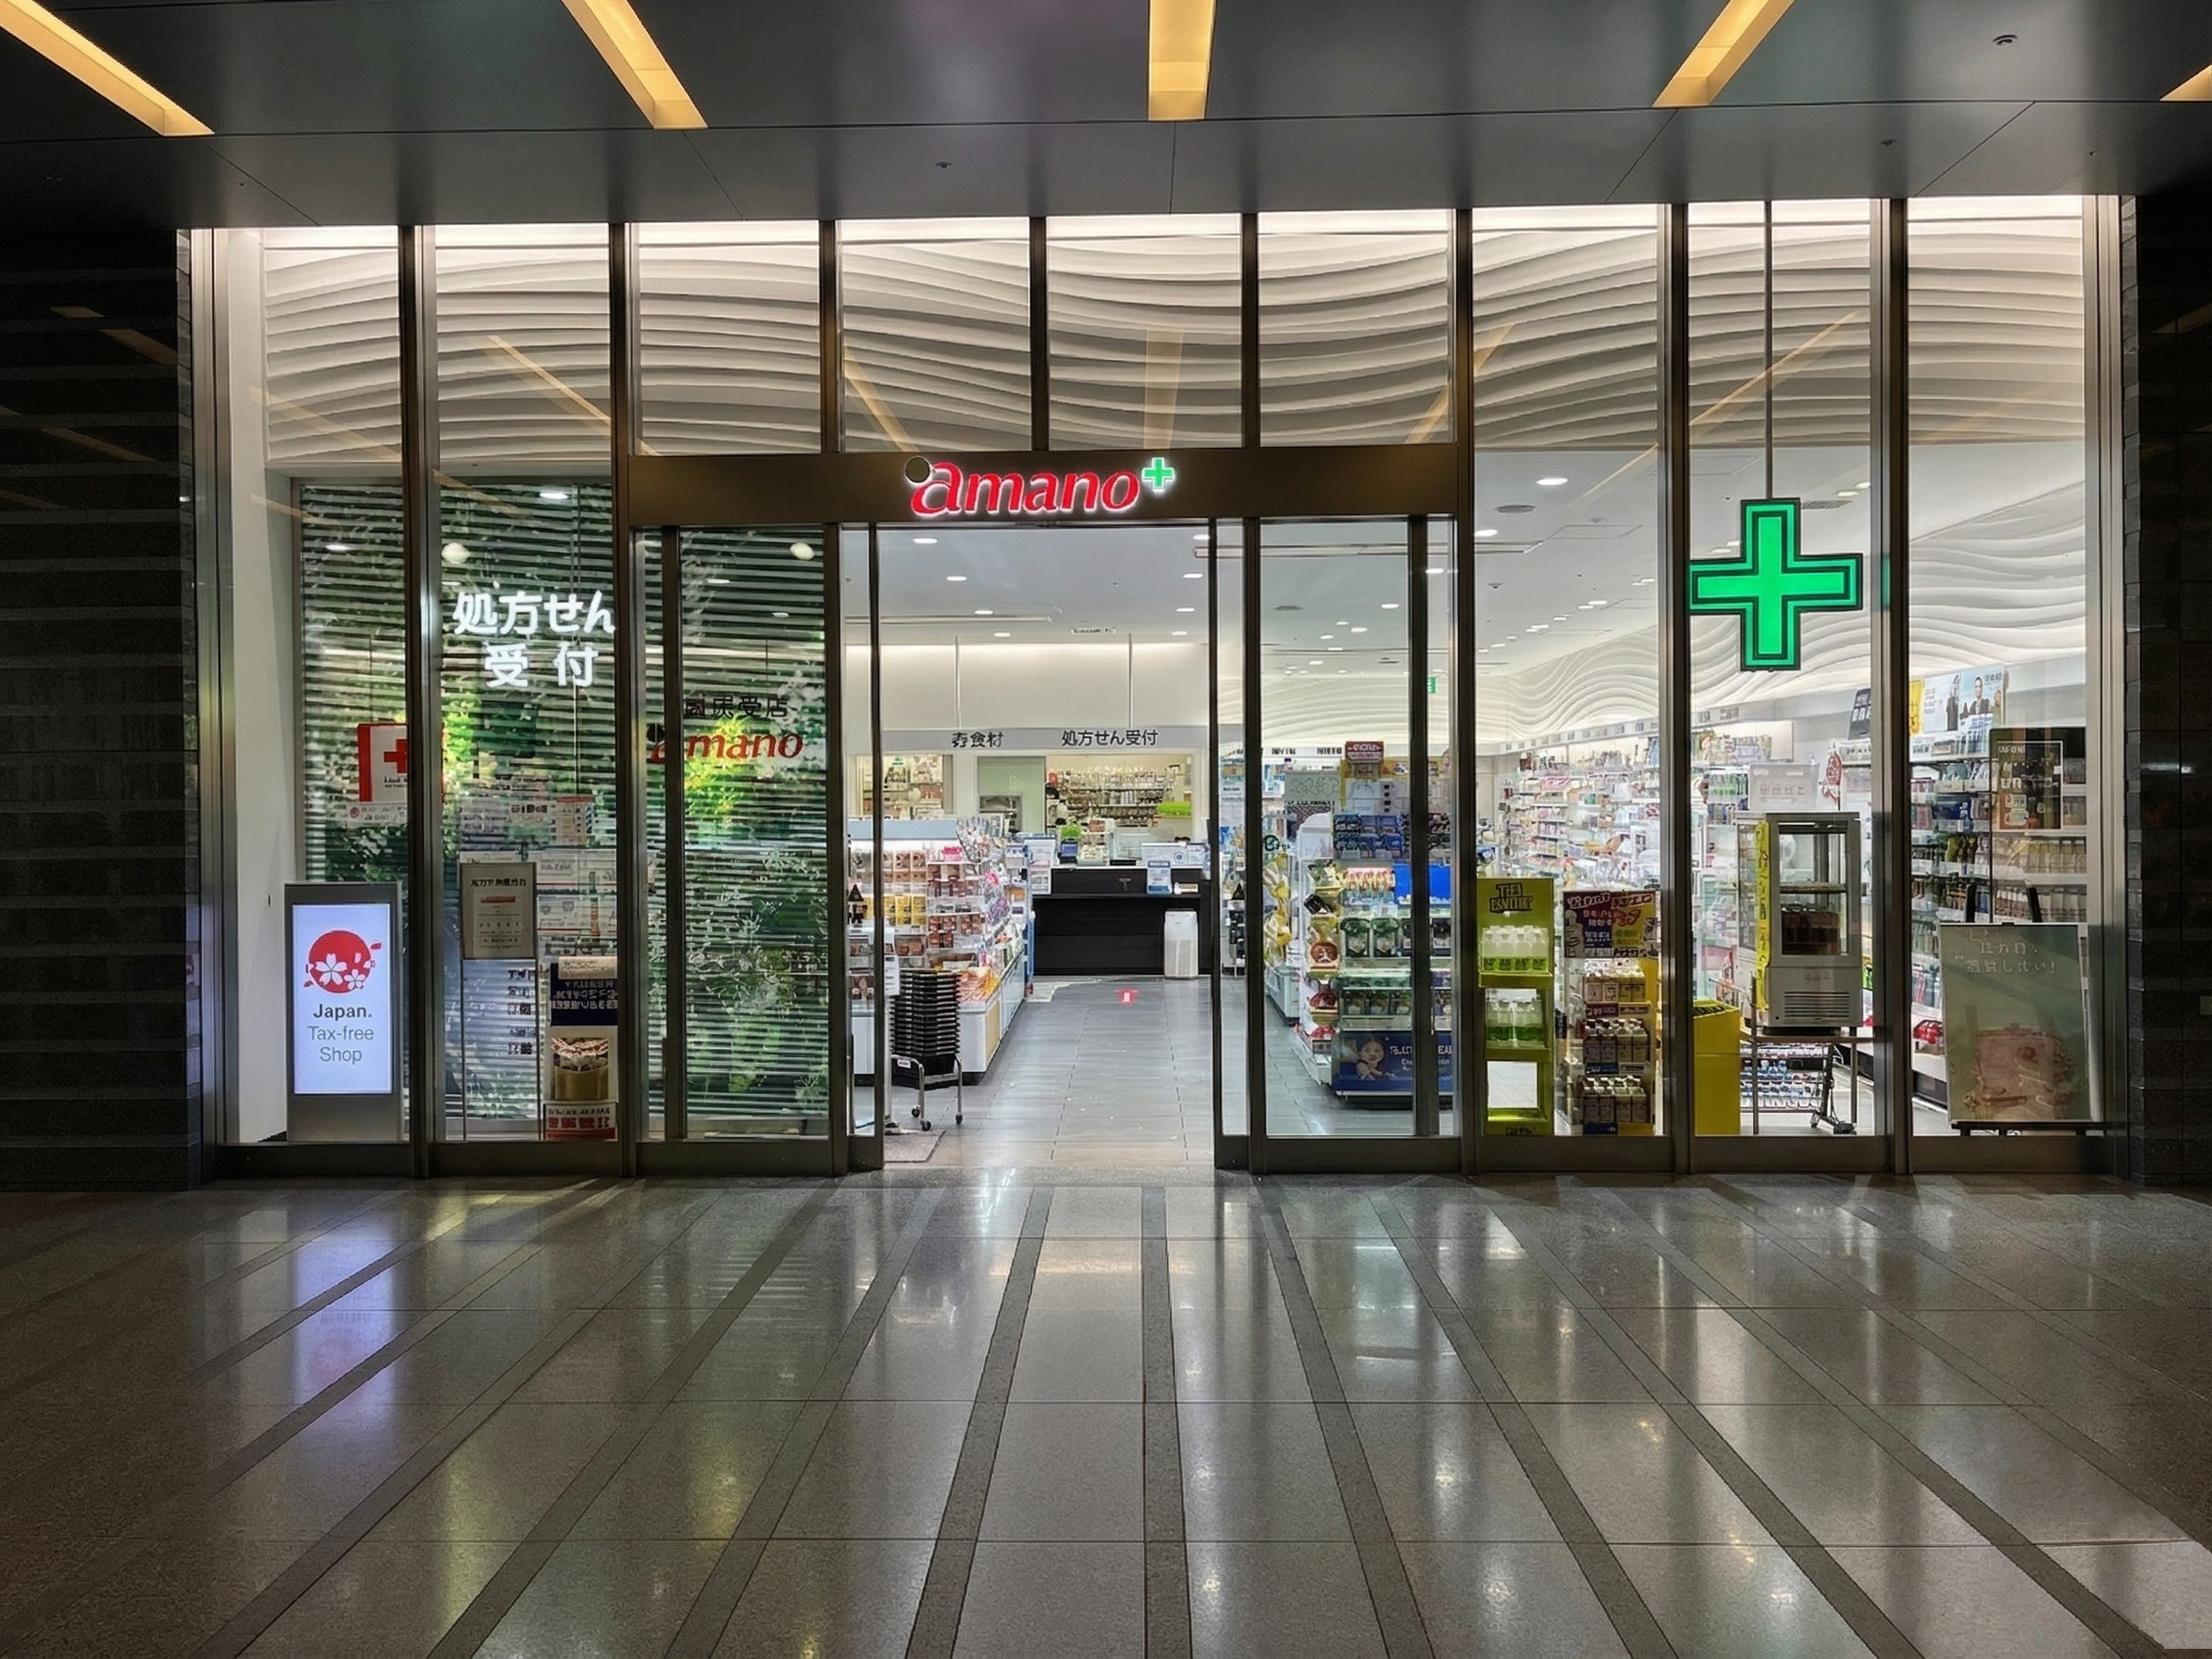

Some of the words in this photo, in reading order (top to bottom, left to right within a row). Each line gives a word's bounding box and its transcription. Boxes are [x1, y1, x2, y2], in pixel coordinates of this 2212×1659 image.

[909, 460, 1141, 517] amano
[452, 590, 616, 635] 処方せん
[1062, 729, 1159, 747] 処方せん受付
[313, 1003, 372, 1022] Japan.
[307, 1025, 375, 1041] Tax-free
[319, 1046, 363, 1065] Shop
